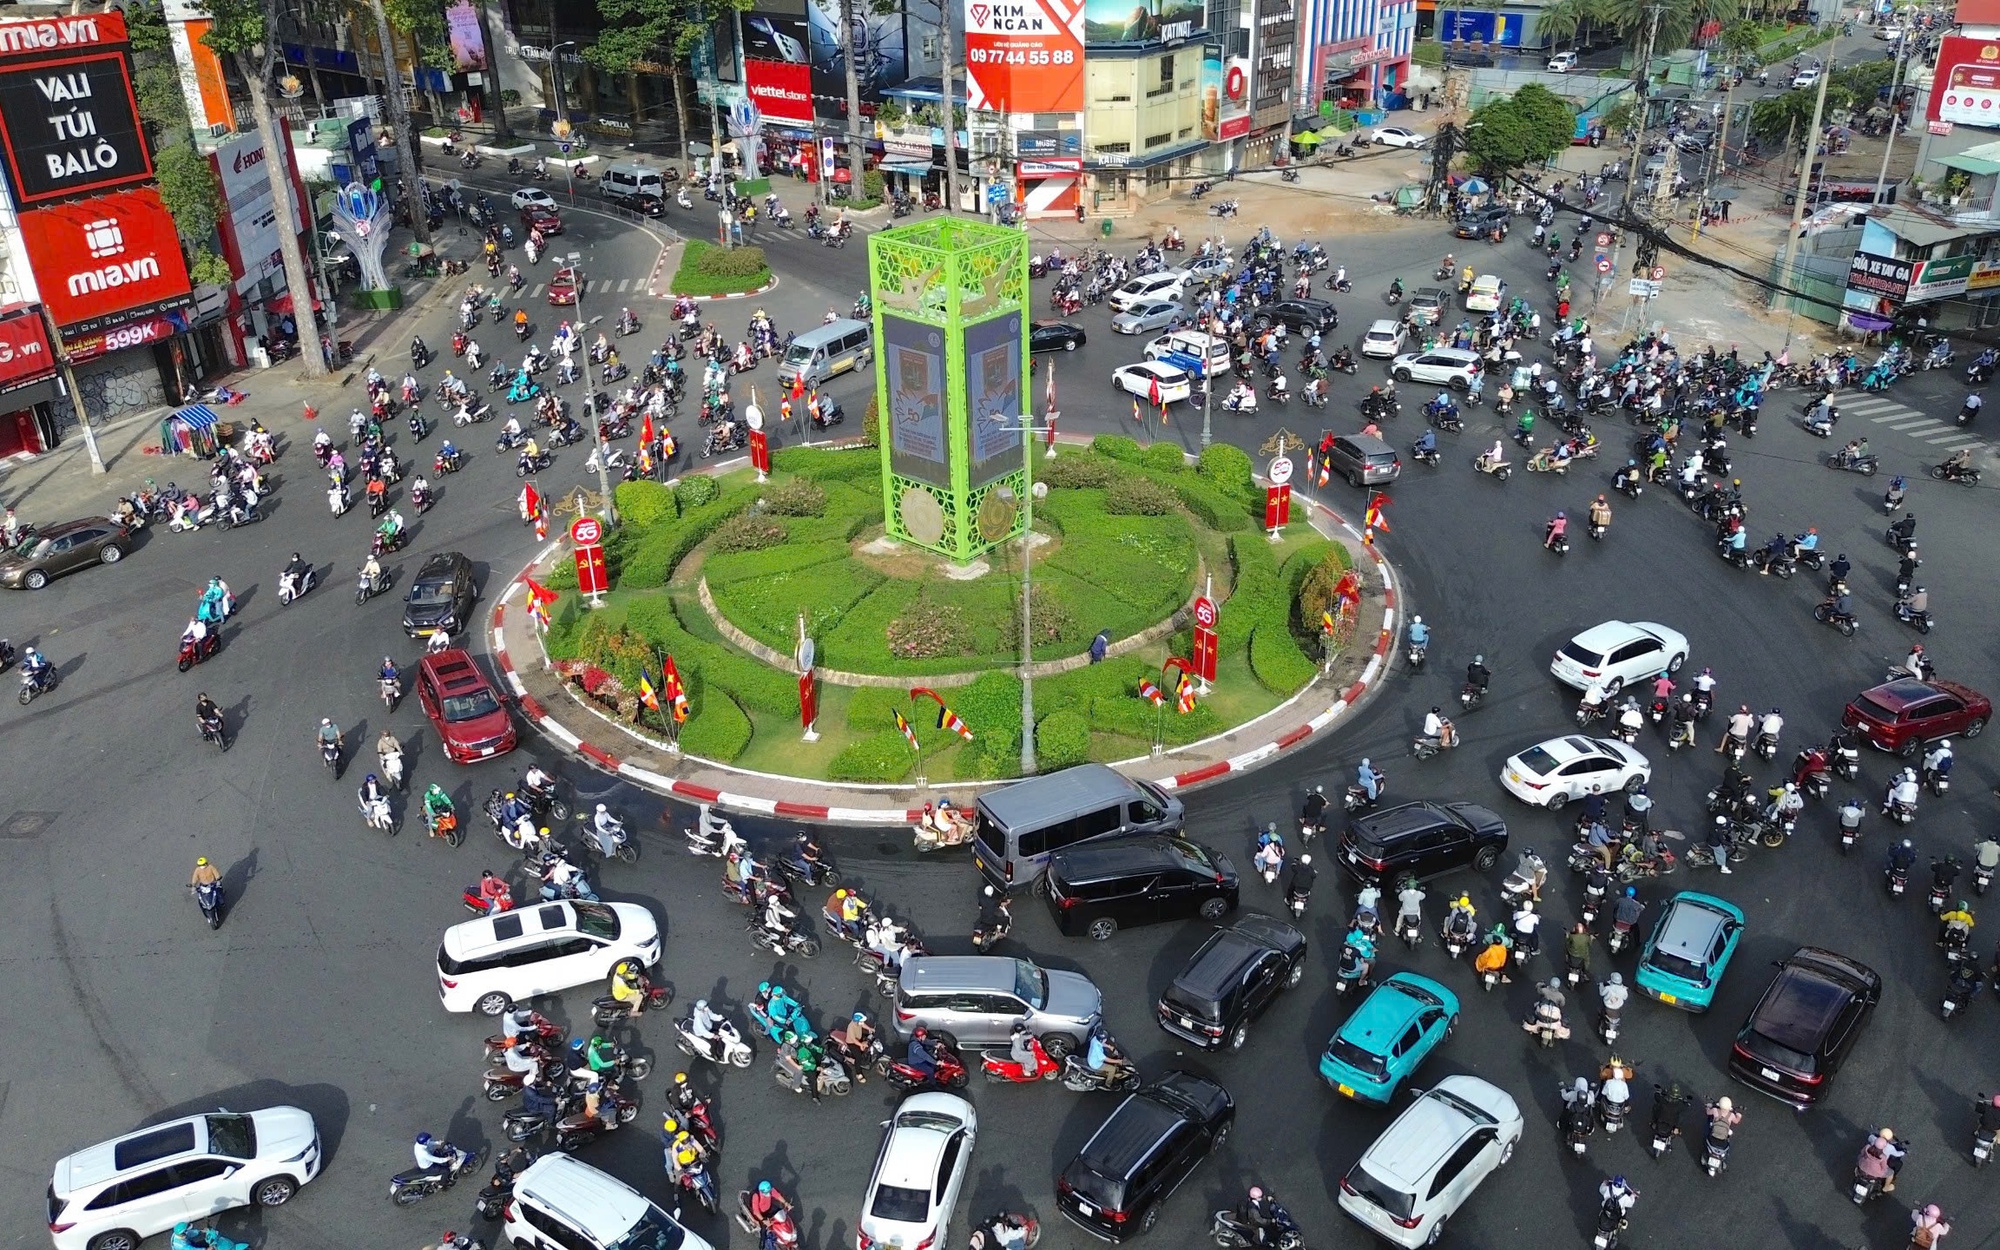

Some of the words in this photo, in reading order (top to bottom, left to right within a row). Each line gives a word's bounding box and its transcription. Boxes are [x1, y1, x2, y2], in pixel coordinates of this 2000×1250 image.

[993, 5, 1023, 17] KIM
[0, 19, 99, 51] mia.vn
[993, 18, 1042, 30] NGAN
[1161, 20, 1192, 44] KATINAT
[1029, 50, 1049, 64] 55
[1052, 49, 1074, 64] 88
[34, 72, 92, 103] VALI
[48, 106, 97, 141] TÚI
[46, 137, 118, 179] BALÔ
[242, 146, 266, 169] HON
[68, 257, 160, 297] mia.vn
[1869, 261, 1881, 274] XE
[1881, 263, 1897, 277] TAY
[1896, 267, 1910, 281] GA
[105, 321, 155, 351] 599K
[576, 526, 597, 541] 5G
[1197, 606, 1212, 624] 5G
